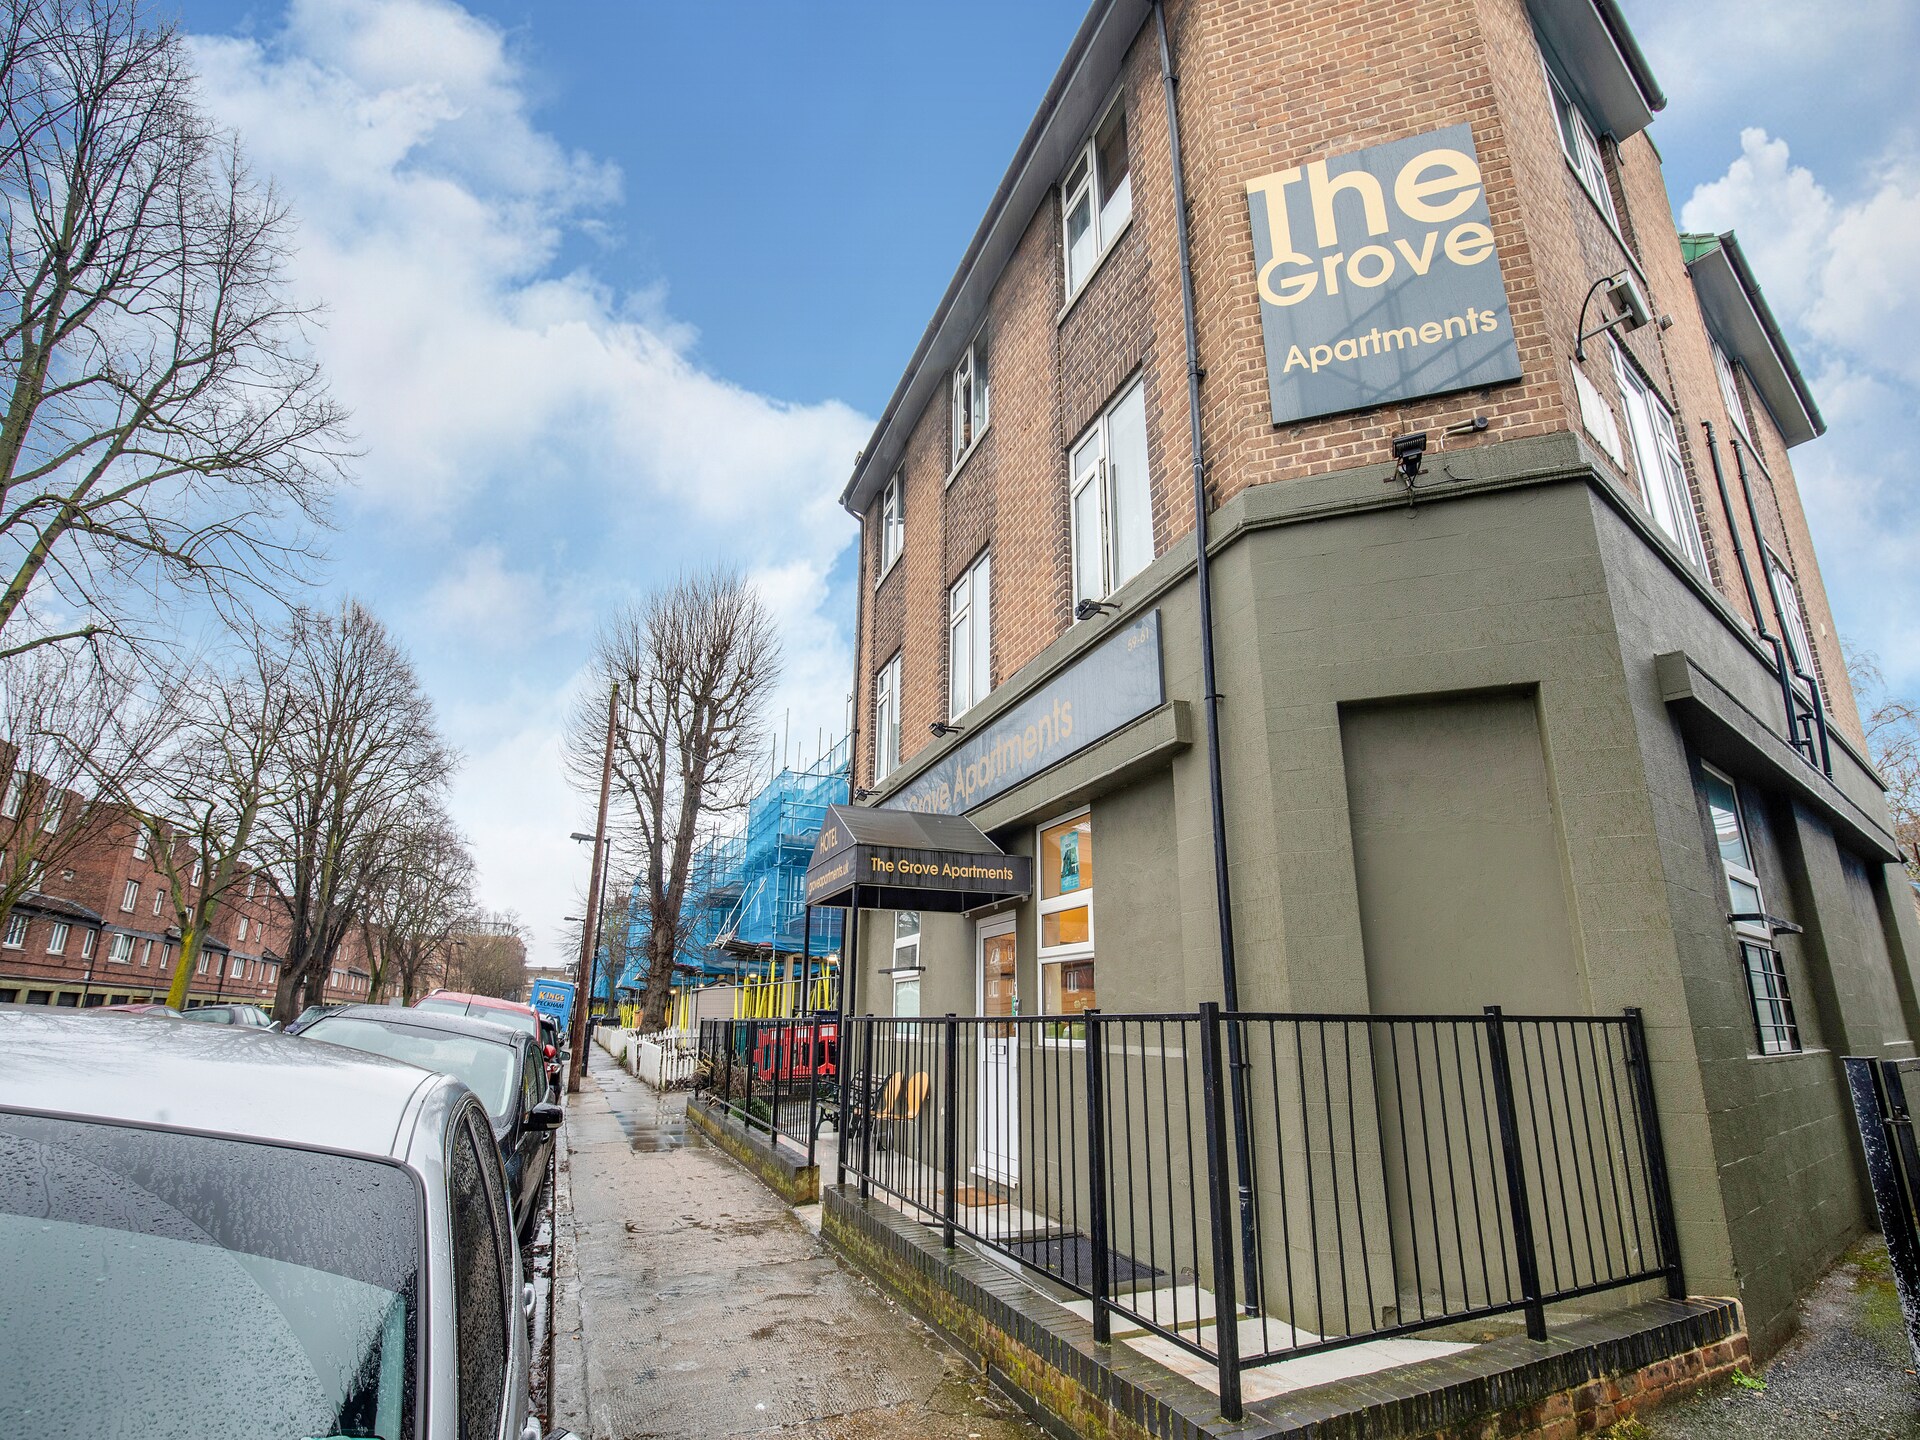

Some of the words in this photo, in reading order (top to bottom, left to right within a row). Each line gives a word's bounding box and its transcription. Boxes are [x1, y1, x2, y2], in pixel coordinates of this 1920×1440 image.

[1246, 149, 1482, 259] The
[1257, 222, 1495, 306] Grove
[1283, 307, 1498, 373] Apartments
[953, 697, 1073, 804] Apartments
[819, 826, 838, 855] HOTEL
[871, 857, 895, 873] The
[898, 859, 939, 876] Grove
[942, 863, 1013, 881] Apartments
[536, 1000, 564, 1008] PECKHAM
[539, 991, 565, 1001] KINGS
